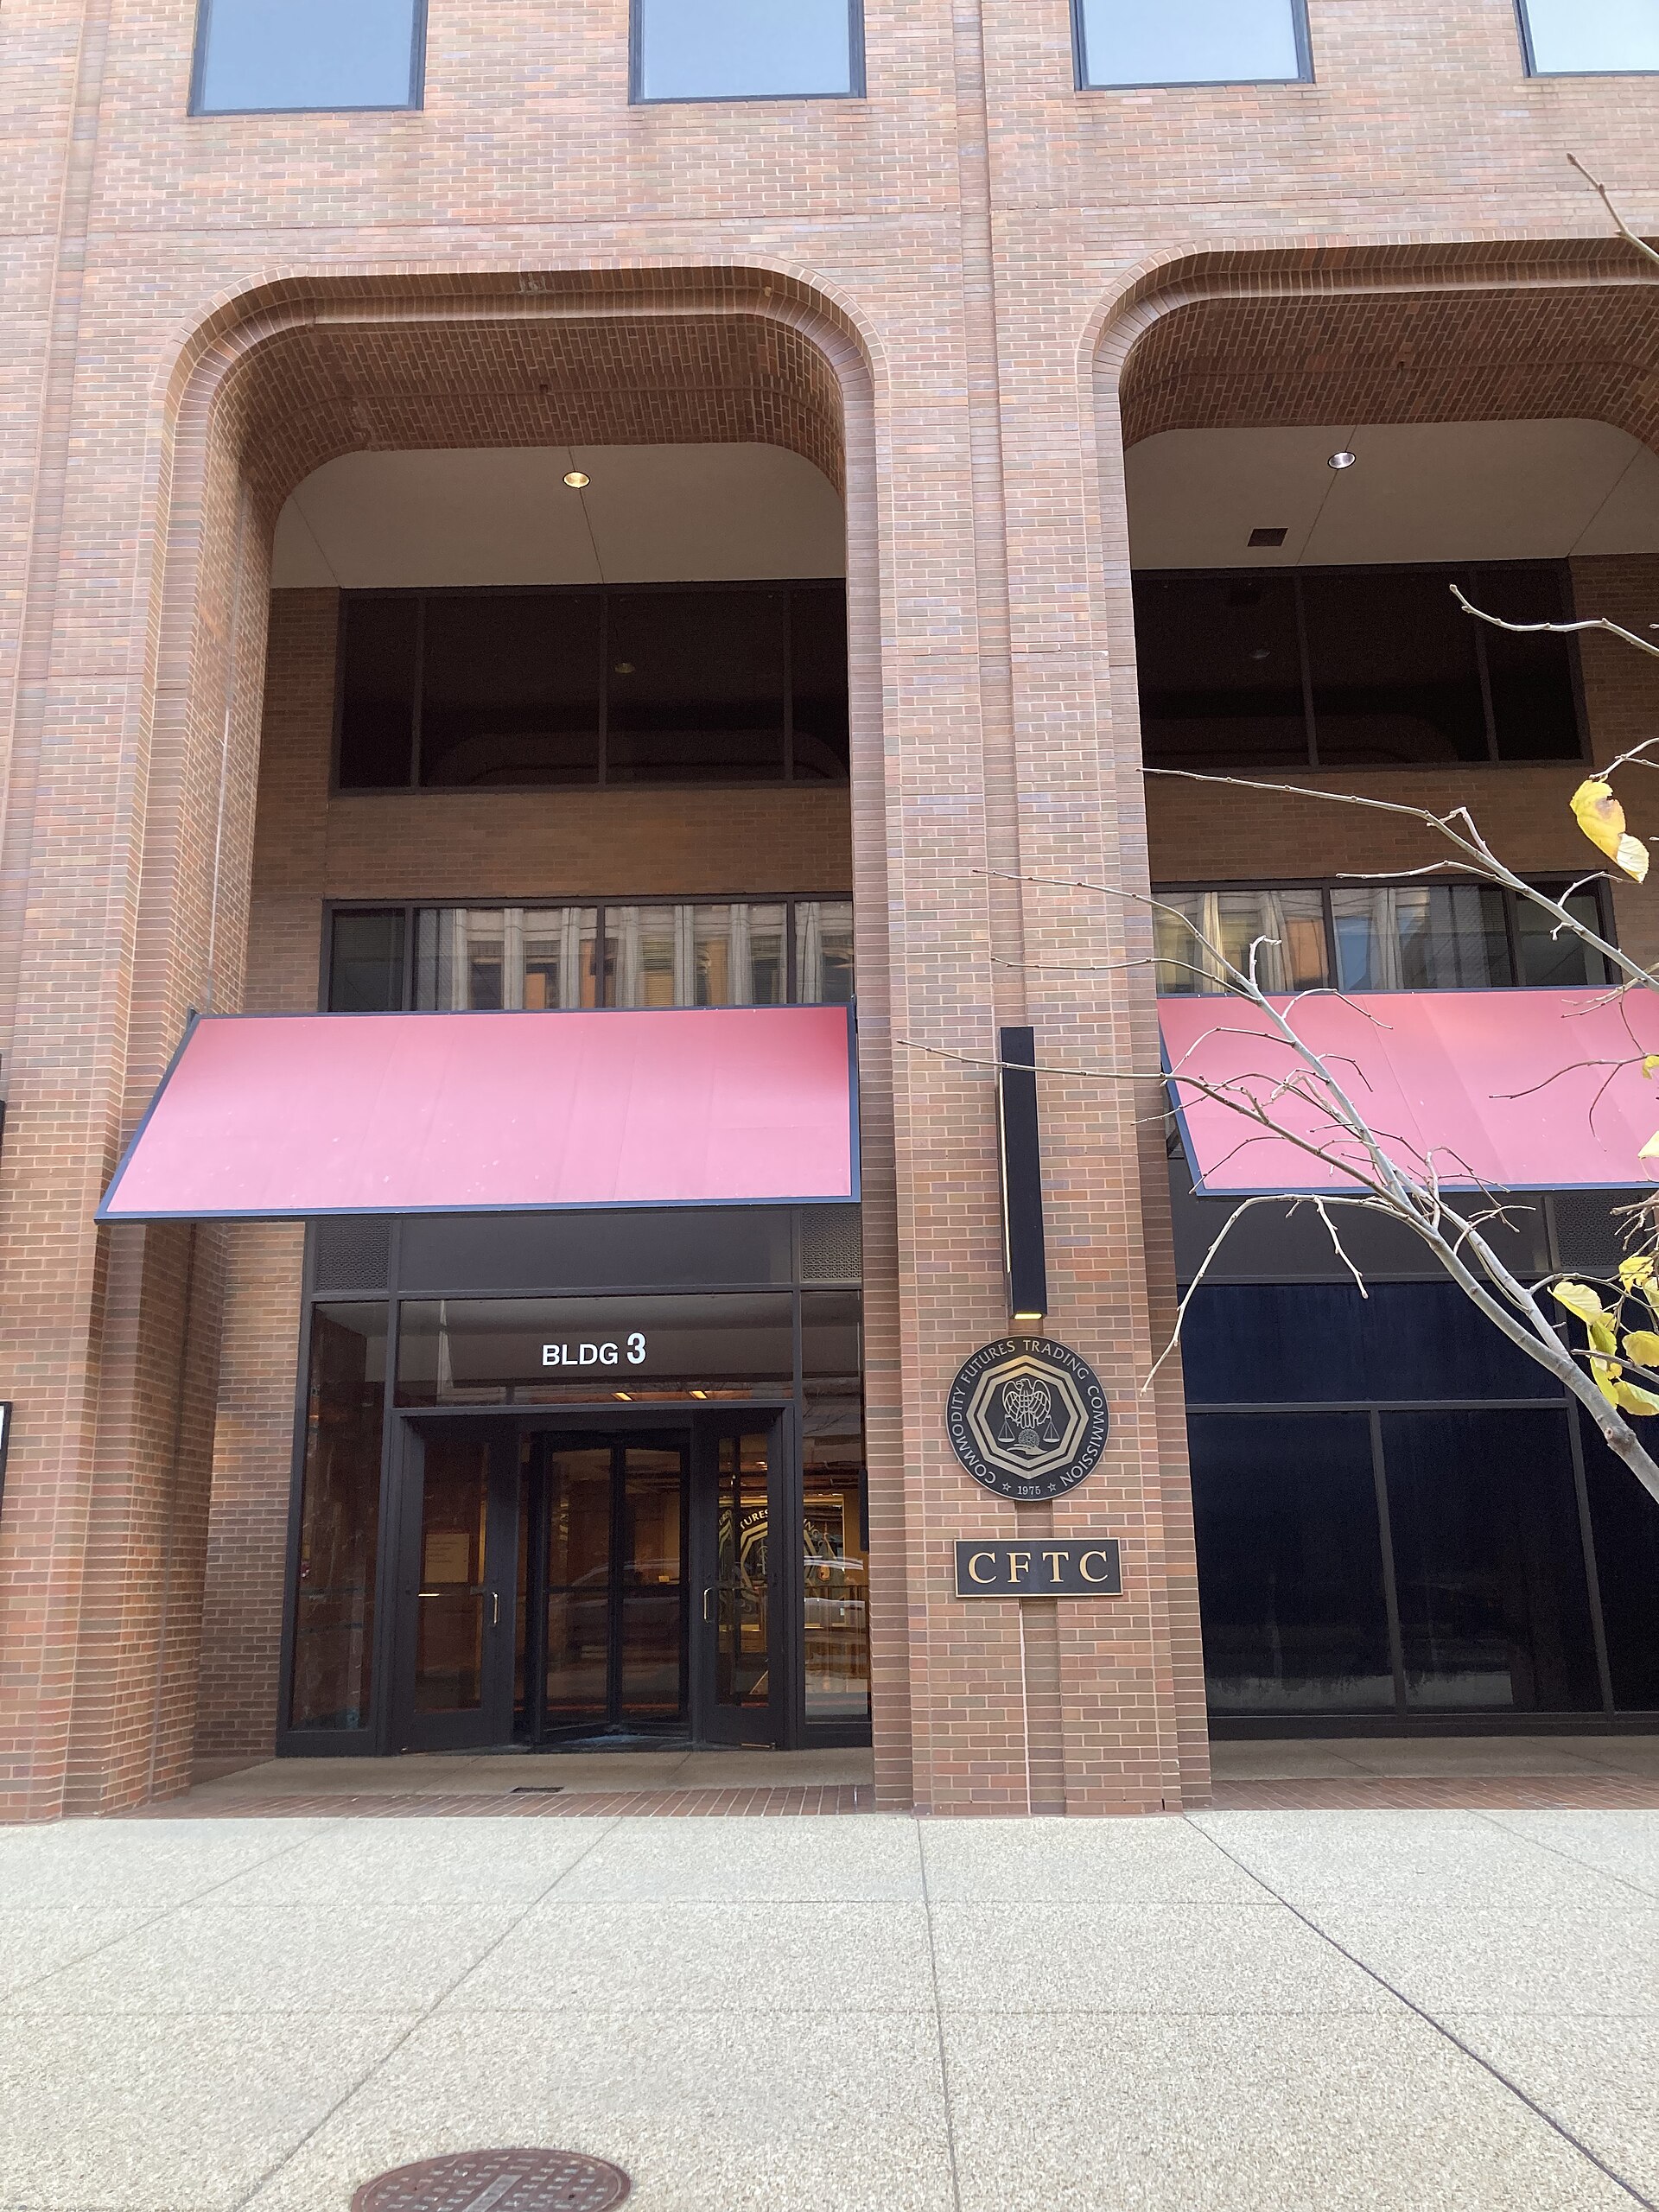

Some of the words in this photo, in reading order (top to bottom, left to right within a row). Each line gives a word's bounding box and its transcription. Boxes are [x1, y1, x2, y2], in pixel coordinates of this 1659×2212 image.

[542, 1342, 619, 1366] BLDG
[626, 1332, 646, 1364] 3
[960, 1340, 1016, 1384] FUTURES
[1023, 1339, 1090, 1380] TRADING
[950, 1387, 997, 1484] COMMODITY
[1059, 1385, 1105, 1487] COMMISSION
[1017, 1485, 1041, 1496] 1975
[968, 1550, 1109, 1584] CFTC
